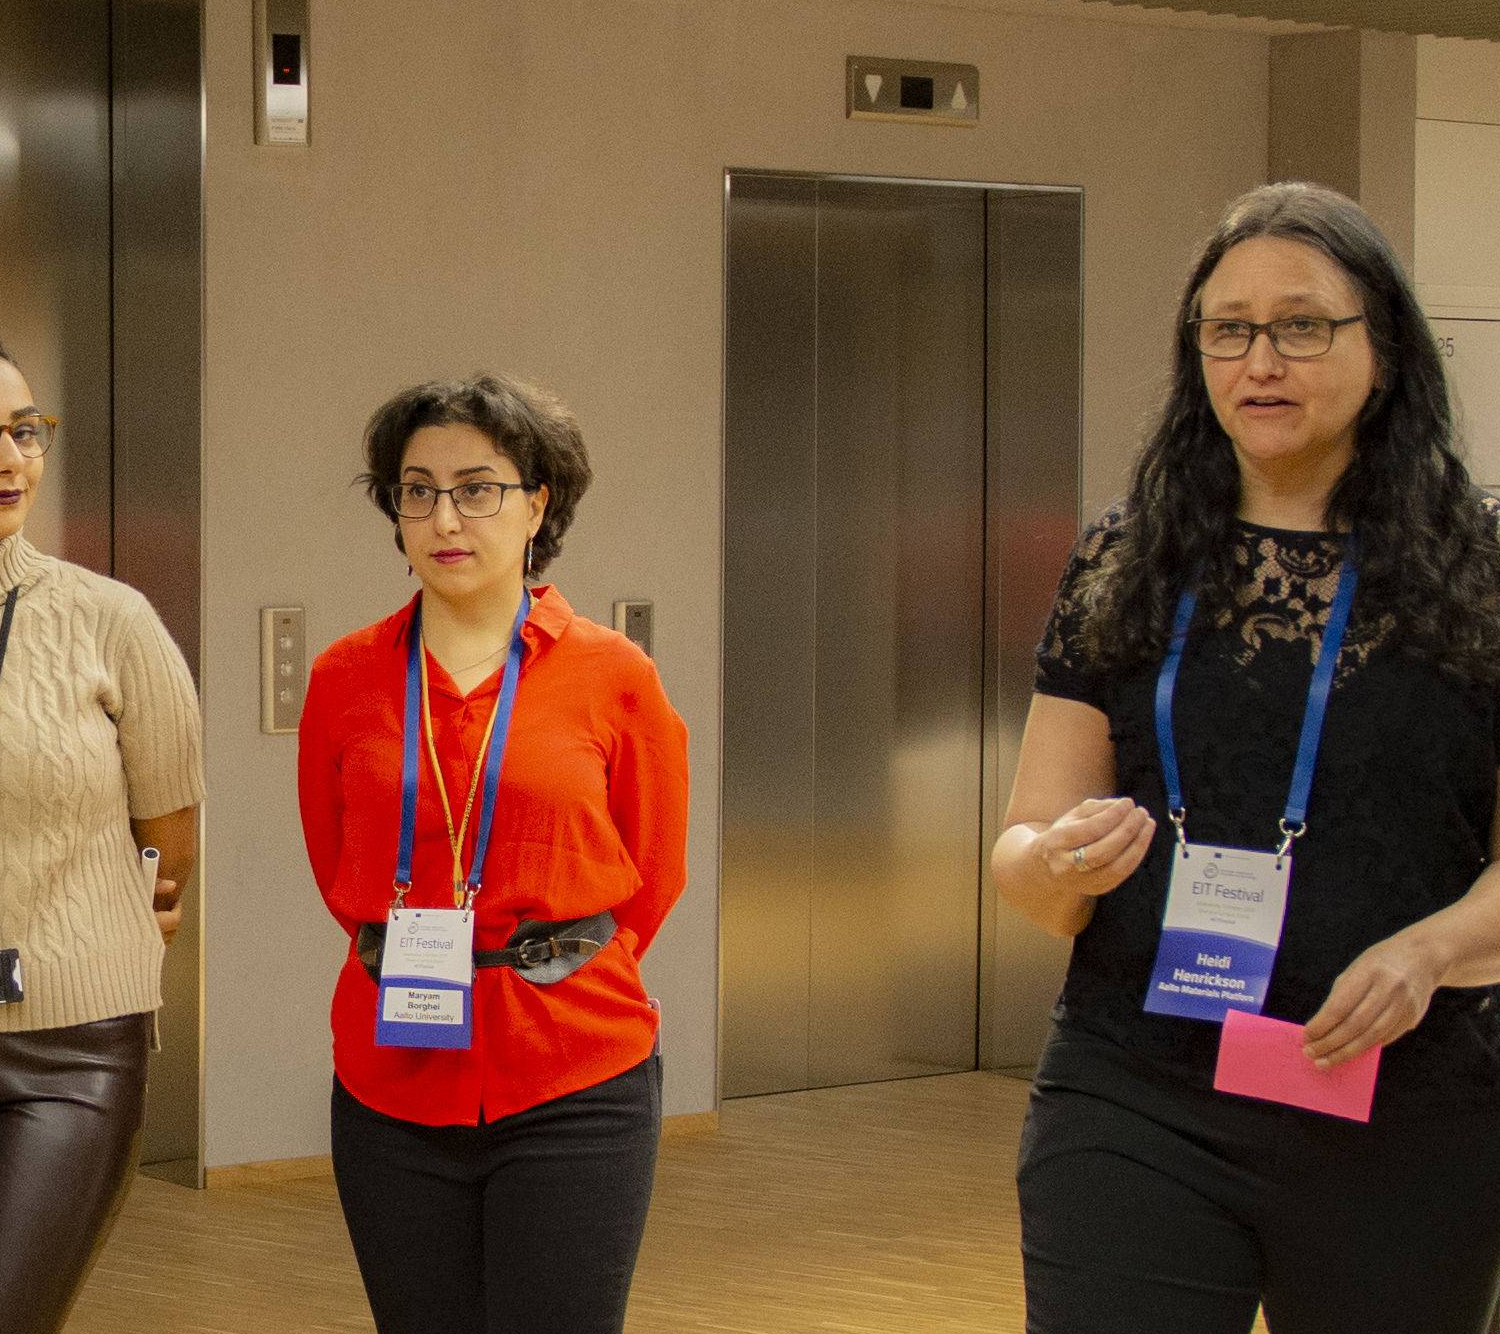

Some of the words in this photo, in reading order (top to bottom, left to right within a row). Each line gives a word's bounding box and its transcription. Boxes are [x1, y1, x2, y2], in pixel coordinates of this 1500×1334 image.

[1436, 337, 1455, 358] 25
[1192, 881, 1212, 896] EIT
[1214, 884, 1264, 903] Festival
[400, 937, 415, 948] EIT
[416, 937, 454, 950] Festival
[1196, 952, 1232, 970] Heidi
[1173, 968, 1246, 990] Henrickson
[408, 991, 440, 1001] Maryam
[407, 1001, 440, 1012] Borghei
[415, 1012, 455, 1023] University
